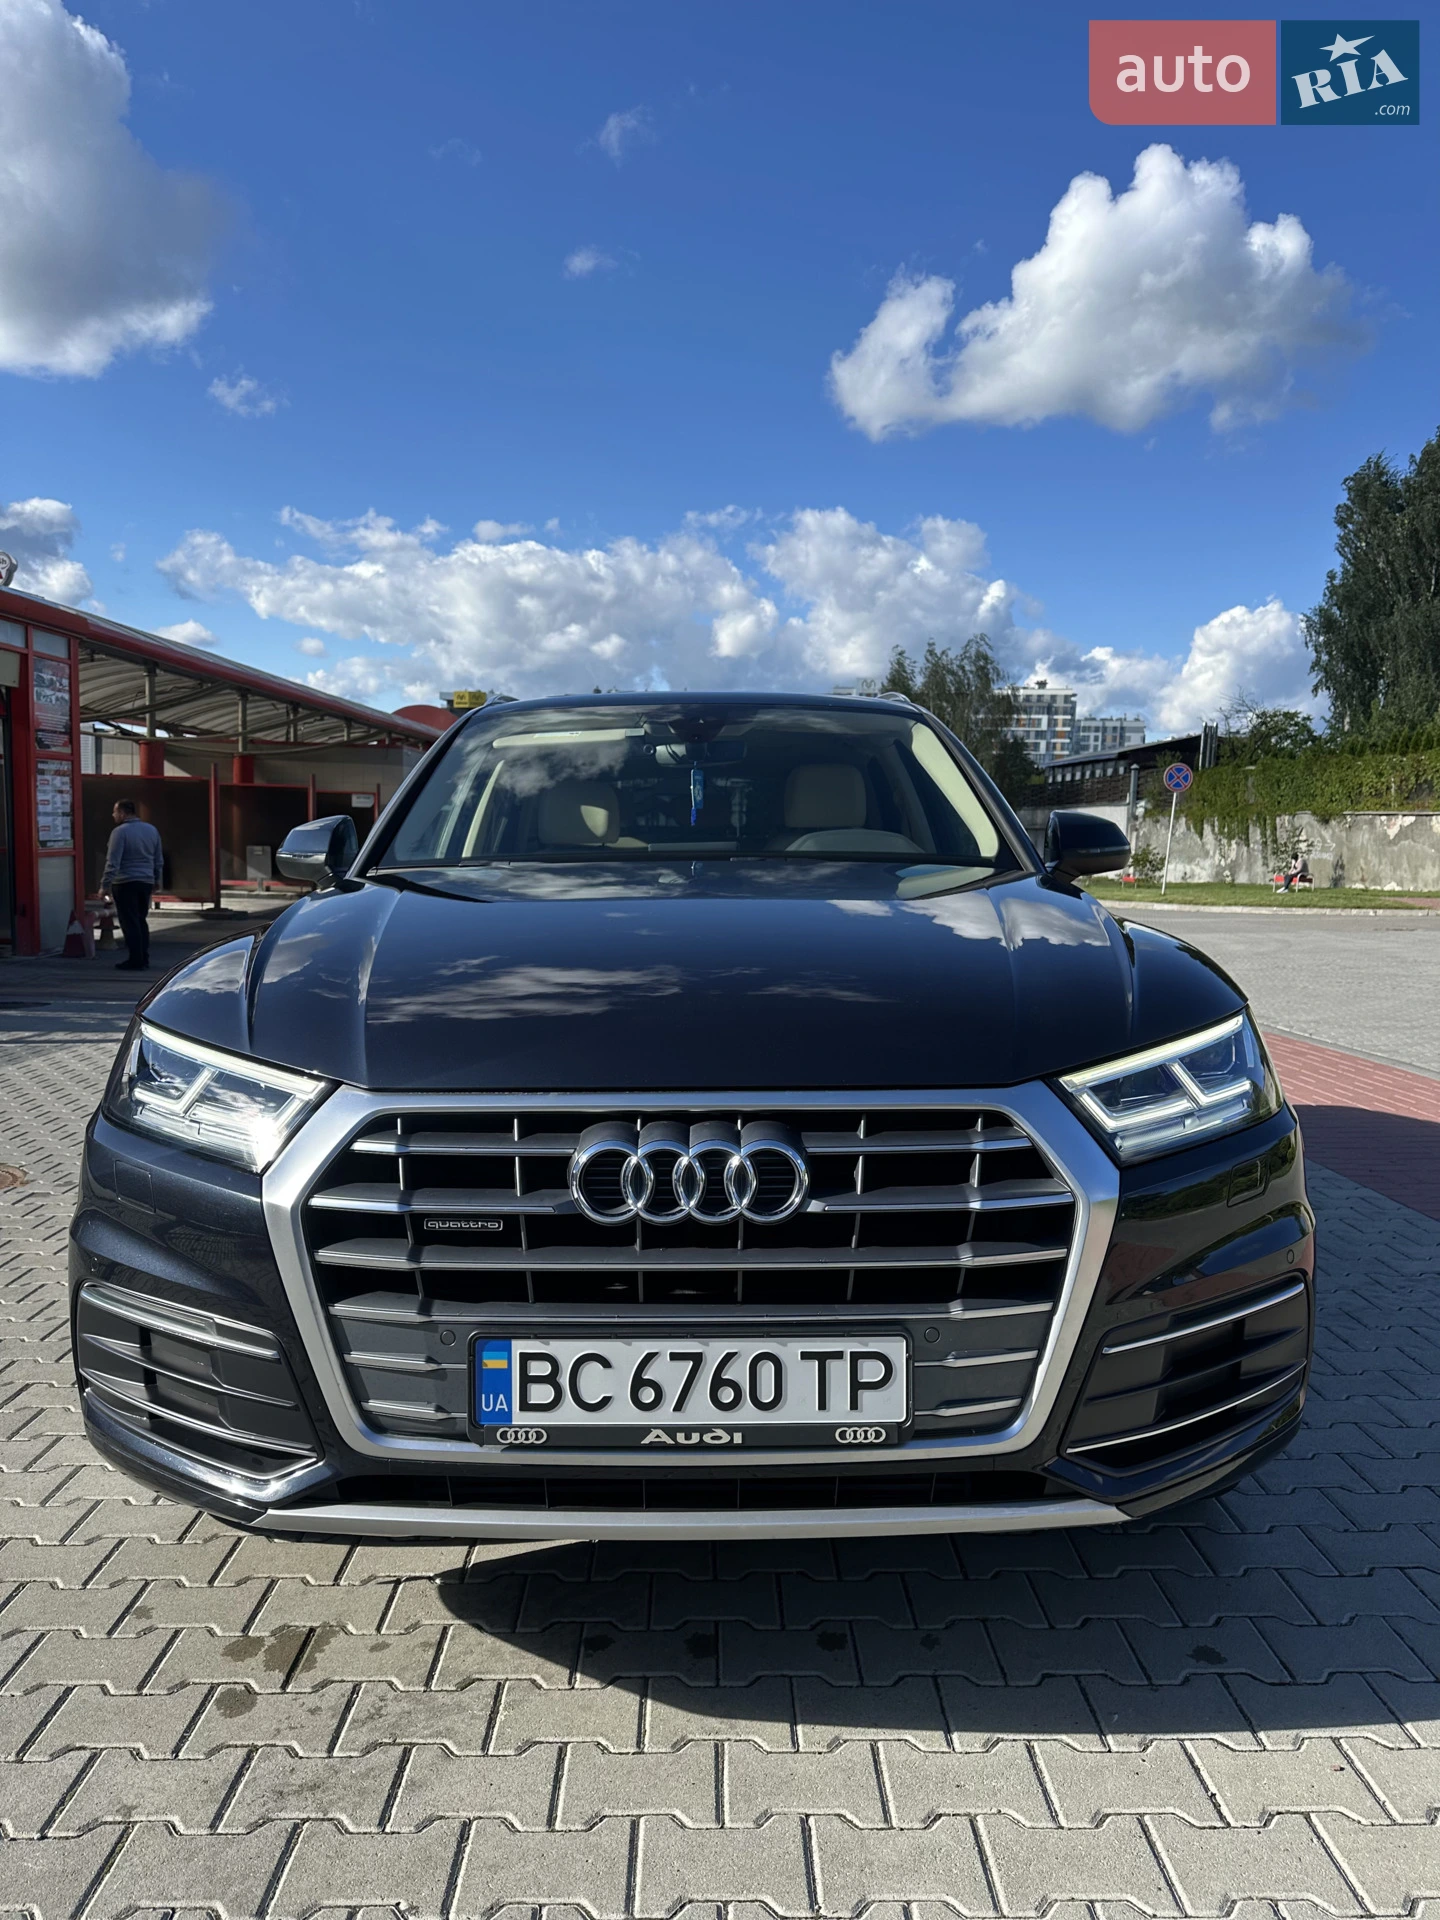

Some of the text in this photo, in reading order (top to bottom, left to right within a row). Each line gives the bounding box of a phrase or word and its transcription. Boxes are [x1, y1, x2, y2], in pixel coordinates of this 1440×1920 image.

[427, 1220, 499, 1229] quattro
[517, 1349, 895, 1413] BC 6760 TP
[481, 1393, 509, 1412] UA
[640, 1428, 743, 1445] Audi
